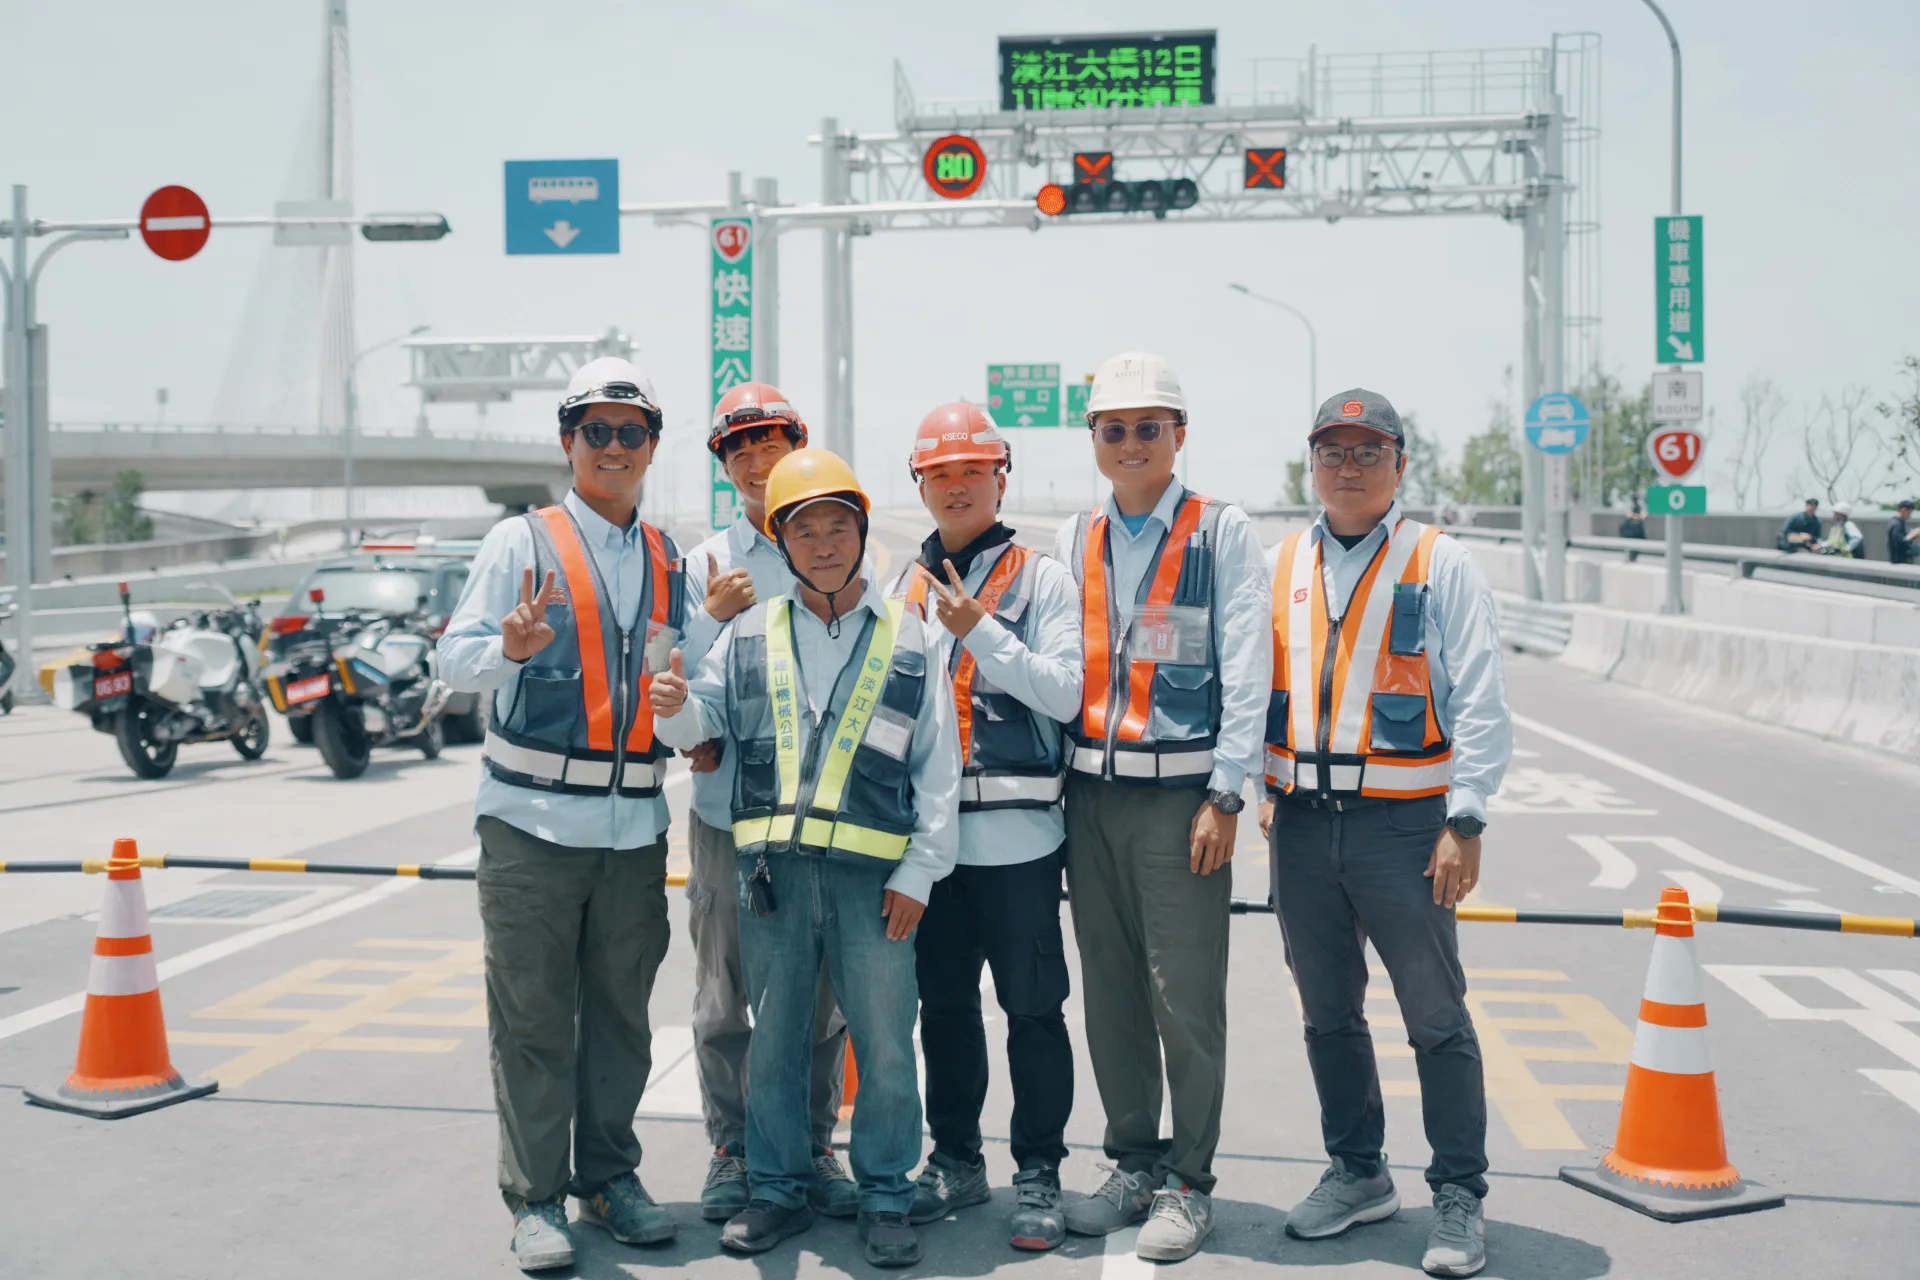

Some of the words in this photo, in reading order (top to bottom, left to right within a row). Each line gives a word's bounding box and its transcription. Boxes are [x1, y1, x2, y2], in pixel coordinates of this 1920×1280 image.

[938, 151, 974, 183] 80
[719, 229, 744, 247] 61
[1667, 219, 1691, 333] 機車專用道
[1668, 380, 1687, 400] 南
[942, 432, 968, 443] KSECO
[1659, 435, 1695, 461] 61
[1668, 489, 1686, 510] 0
[837, 676, 876, 753] 淡江大橋
